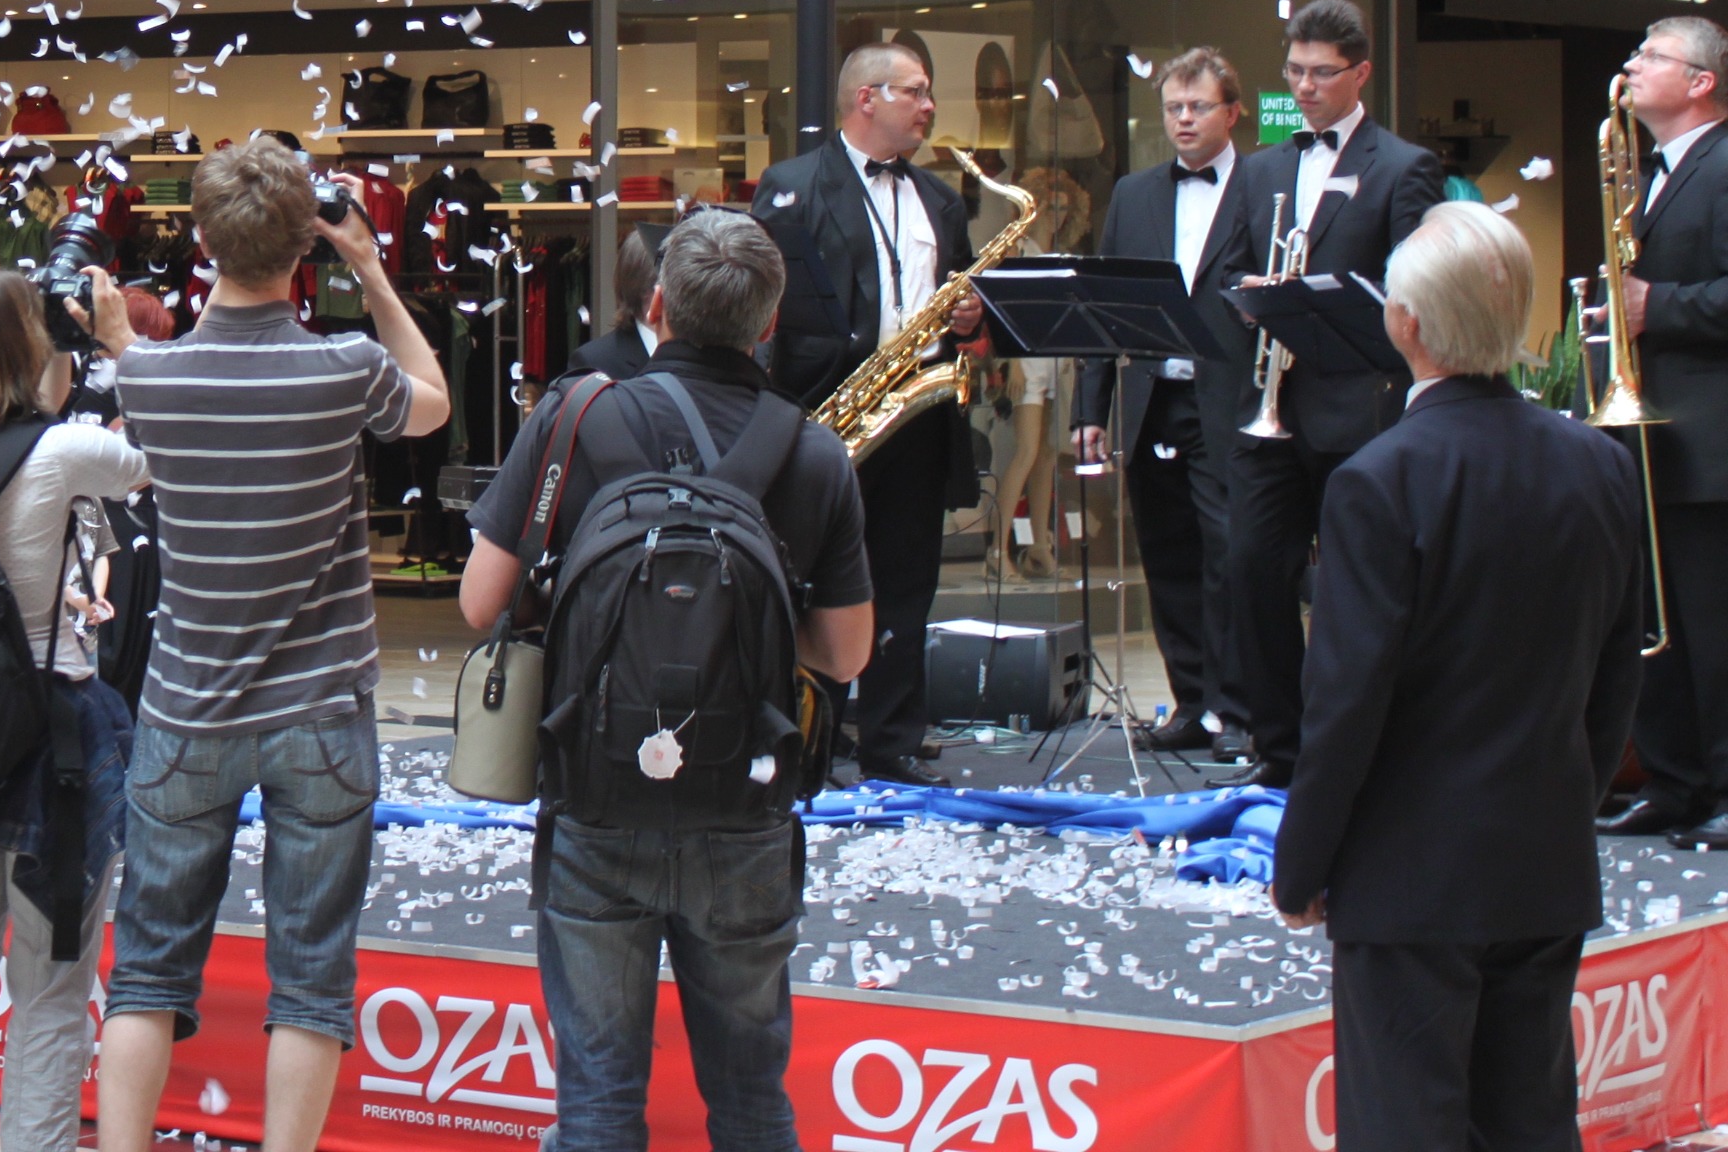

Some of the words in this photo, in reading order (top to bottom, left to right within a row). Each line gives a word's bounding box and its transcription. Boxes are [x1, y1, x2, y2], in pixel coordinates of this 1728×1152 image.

[1261, 98, 1295, 111] UNITED
[1261, 113, 1274, 126] OF
[533, 463, 562, 524] Canon
[359, 986, 557, 1104] OZA
[831, 1038, 1099, 1152] OZAS
[362, 1103, 435, 1126] PREKYBOS
[437, 1114, 452, 1128] IR
[454, 1116, 524, 1140] PRAMOGŲ
